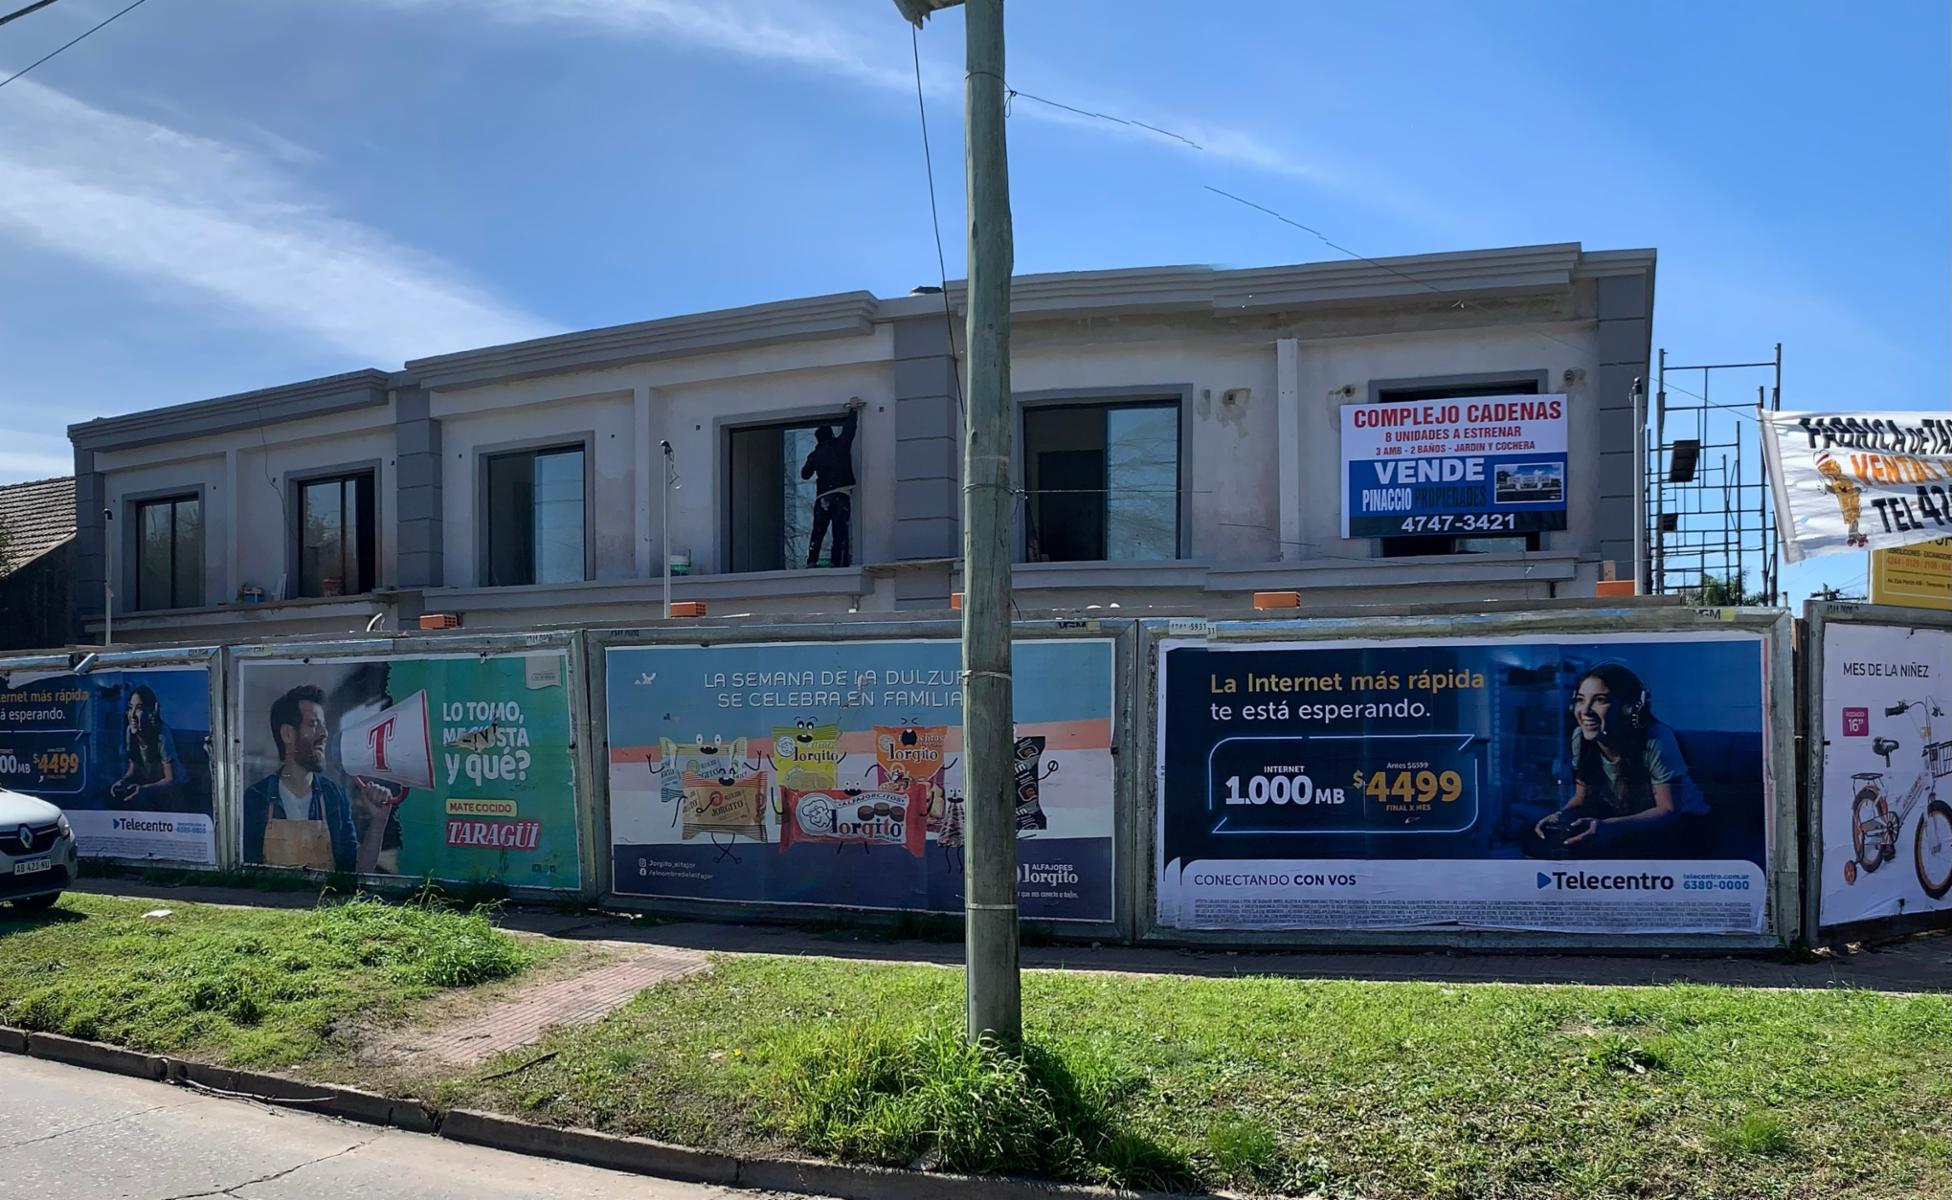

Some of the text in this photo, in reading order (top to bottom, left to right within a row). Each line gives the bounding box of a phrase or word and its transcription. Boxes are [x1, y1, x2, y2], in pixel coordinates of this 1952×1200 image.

[1353, 400, 1562, 428] COMPLEJO CADENAS
[1384, 426, 1522, 443] 8 UNIDADES A ESTRENAR
[1375, 447, 1382, 456] 3
[1383, 446, 1402, 456] AMB
[1410, 446, 1416, 454] 2
[1454, 442, 1486, 453] JARDIN
[1487, 442, 1493, 451] Y
[1495, 440, 1536, 451] COCHERA
[1373, 458, 1486, 485] VENDE
[1850, 453, 1943, 486] VENTAS
[1362, 486, 1487, 512] PINACCIO PROPIEDADES
[1870, 485, 1952, 533] TEL 42
[1400, 513, 1515, 533] 4747-3421
[704, 669, 964, 688] LA SEMANA DE LA DULZUR
[1843, 661, 1929, 678] MES DE LA NIÑEZ
[1211, 669, 1485, 694] La Internet más rápida
[30, 688, 53, 702] más
[55, 687, 89, 705] rápida
[718, 690, 963, 708] SE CELEBRA EN FAMILIA
[9, 707, 66, 722] esperando.
[442, 701, 524, 724] LO TOMO,
[1210, 698, 1431, 724] te está esperando.
[367, 713, 397, 773] T
[18, 762, 31, 774] MB
[33, 752, 79, 774] $4499
[445, 746, 531, 787] y qué?
[1264, 765, 1305, 773] INTERNET
[1225, 769, 1462, 805] 1.000 MB $4499
[450, 802, 512, 813] MATE COCIDO
[120, 817, 173, 833] Telecentro
[1031, 863, 1074, 871] ALFAJORES
[1194, 874, 1357, 886] CONECTANDO CON VOS
[1552, 871, 1674, 891] Telecentro
[1683, 880, 1750, 891] 6380-0000
